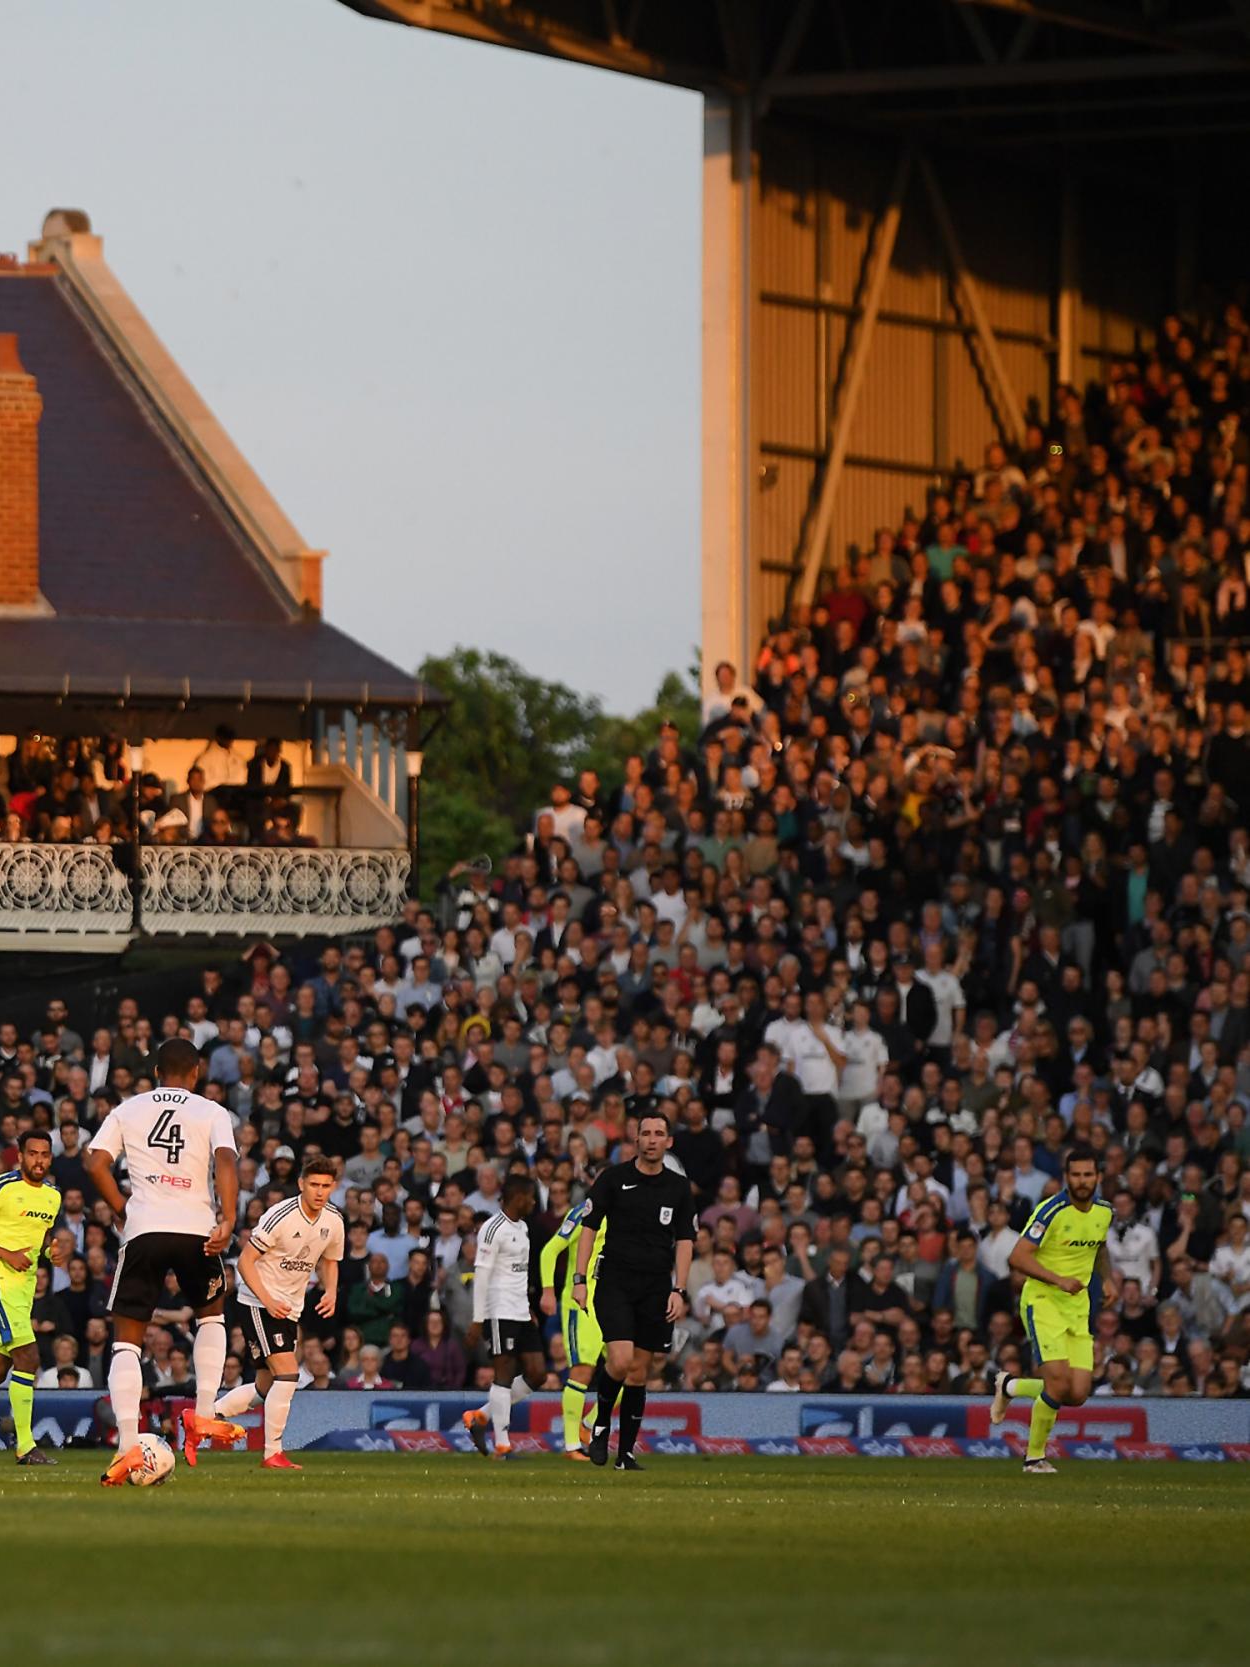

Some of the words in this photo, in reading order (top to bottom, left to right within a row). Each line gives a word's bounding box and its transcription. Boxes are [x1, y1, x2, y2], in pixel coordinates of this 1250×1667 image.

[152, 1094, 189, 1105] ODOI
[148, 1110, 185, 1164] 4
[161, 1175, 192, 1188] PES
